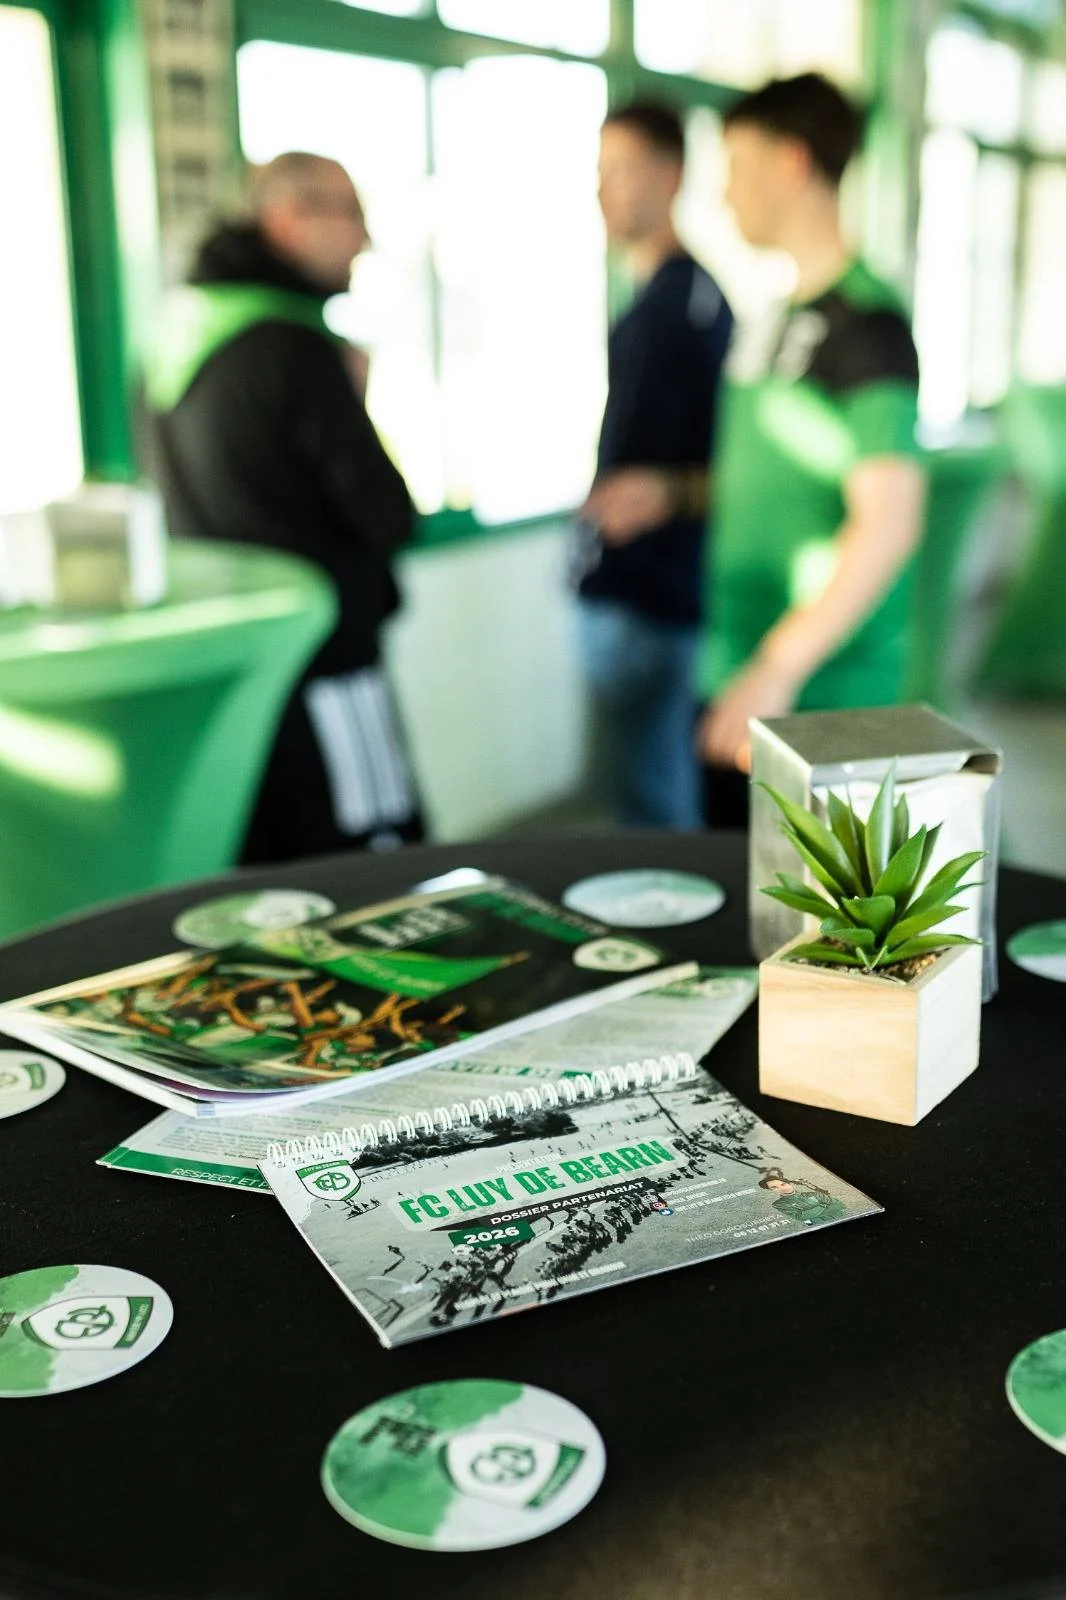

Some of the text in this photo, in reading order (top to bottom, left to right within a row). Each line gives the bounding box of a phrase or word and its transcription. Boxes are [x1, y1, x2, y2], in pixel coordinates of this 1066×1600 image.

[171, 1168, 240, 1184] RESPECT
[238, 1178, 260, 1187] ET
[399, 1140, 676, 1224] FC LUY DE BEARN
[490, 1205, 550, 1225] DOSSIER
[552, 1181, 645, 1210] PARTENARIAT
[463, 1226, 520, 1245] 2026
